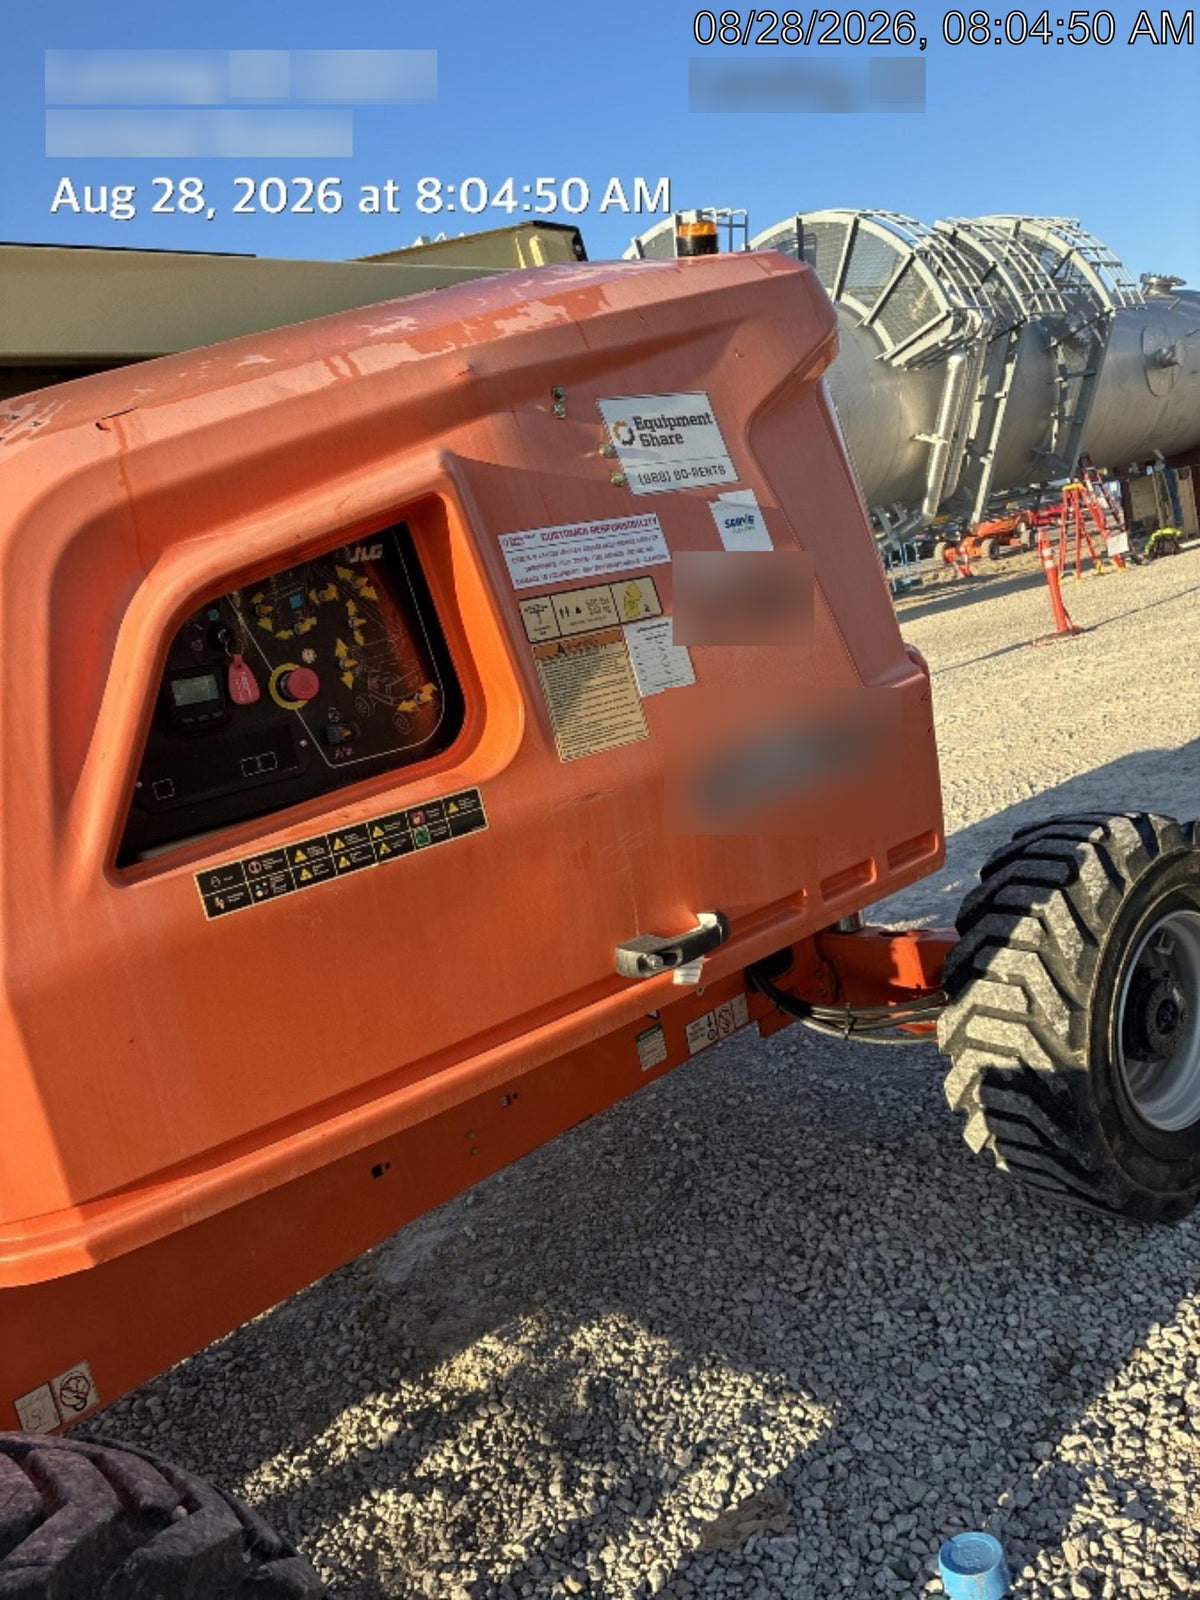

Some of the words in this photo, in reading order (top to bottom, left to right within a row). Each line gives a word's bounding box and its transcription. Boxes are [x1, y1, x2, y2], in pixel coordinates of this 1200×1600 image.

[632, 412, 714, 433] Equipment
[639, 433, 685, 448] Share
[350, 544, 384, 563] JLG
